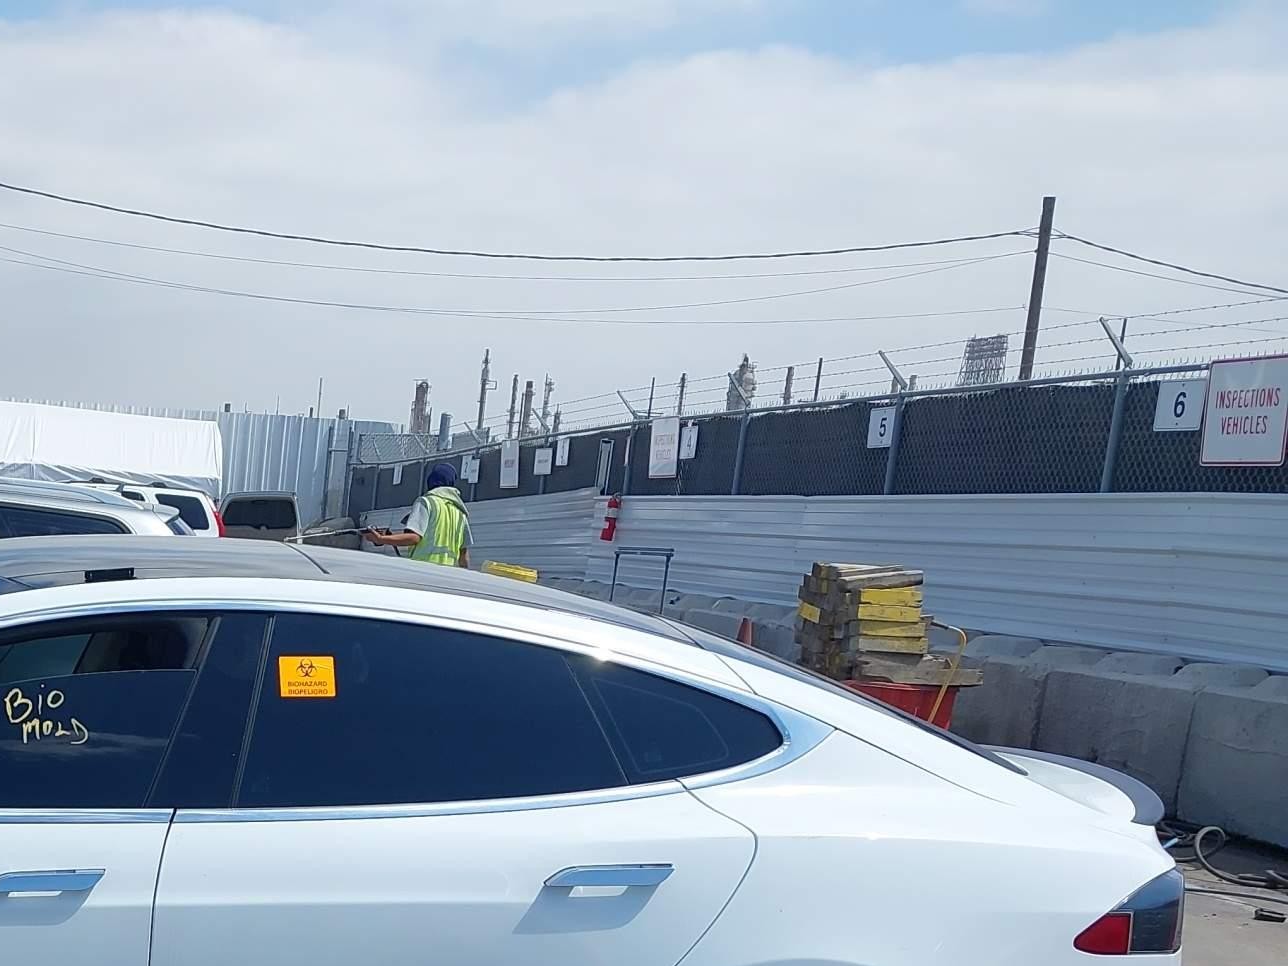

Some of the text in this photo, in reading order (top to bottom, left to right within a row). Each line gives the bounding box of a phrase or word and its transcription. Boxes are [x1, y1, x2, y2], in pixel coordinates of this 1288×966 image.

[1173, 391, 1187, 418] 6
[1215, 387, 1281, 409] INSPECTIONS
[879, 416, 888, 437] 5
[1220, 415, 1268, 435] VEHICLES
